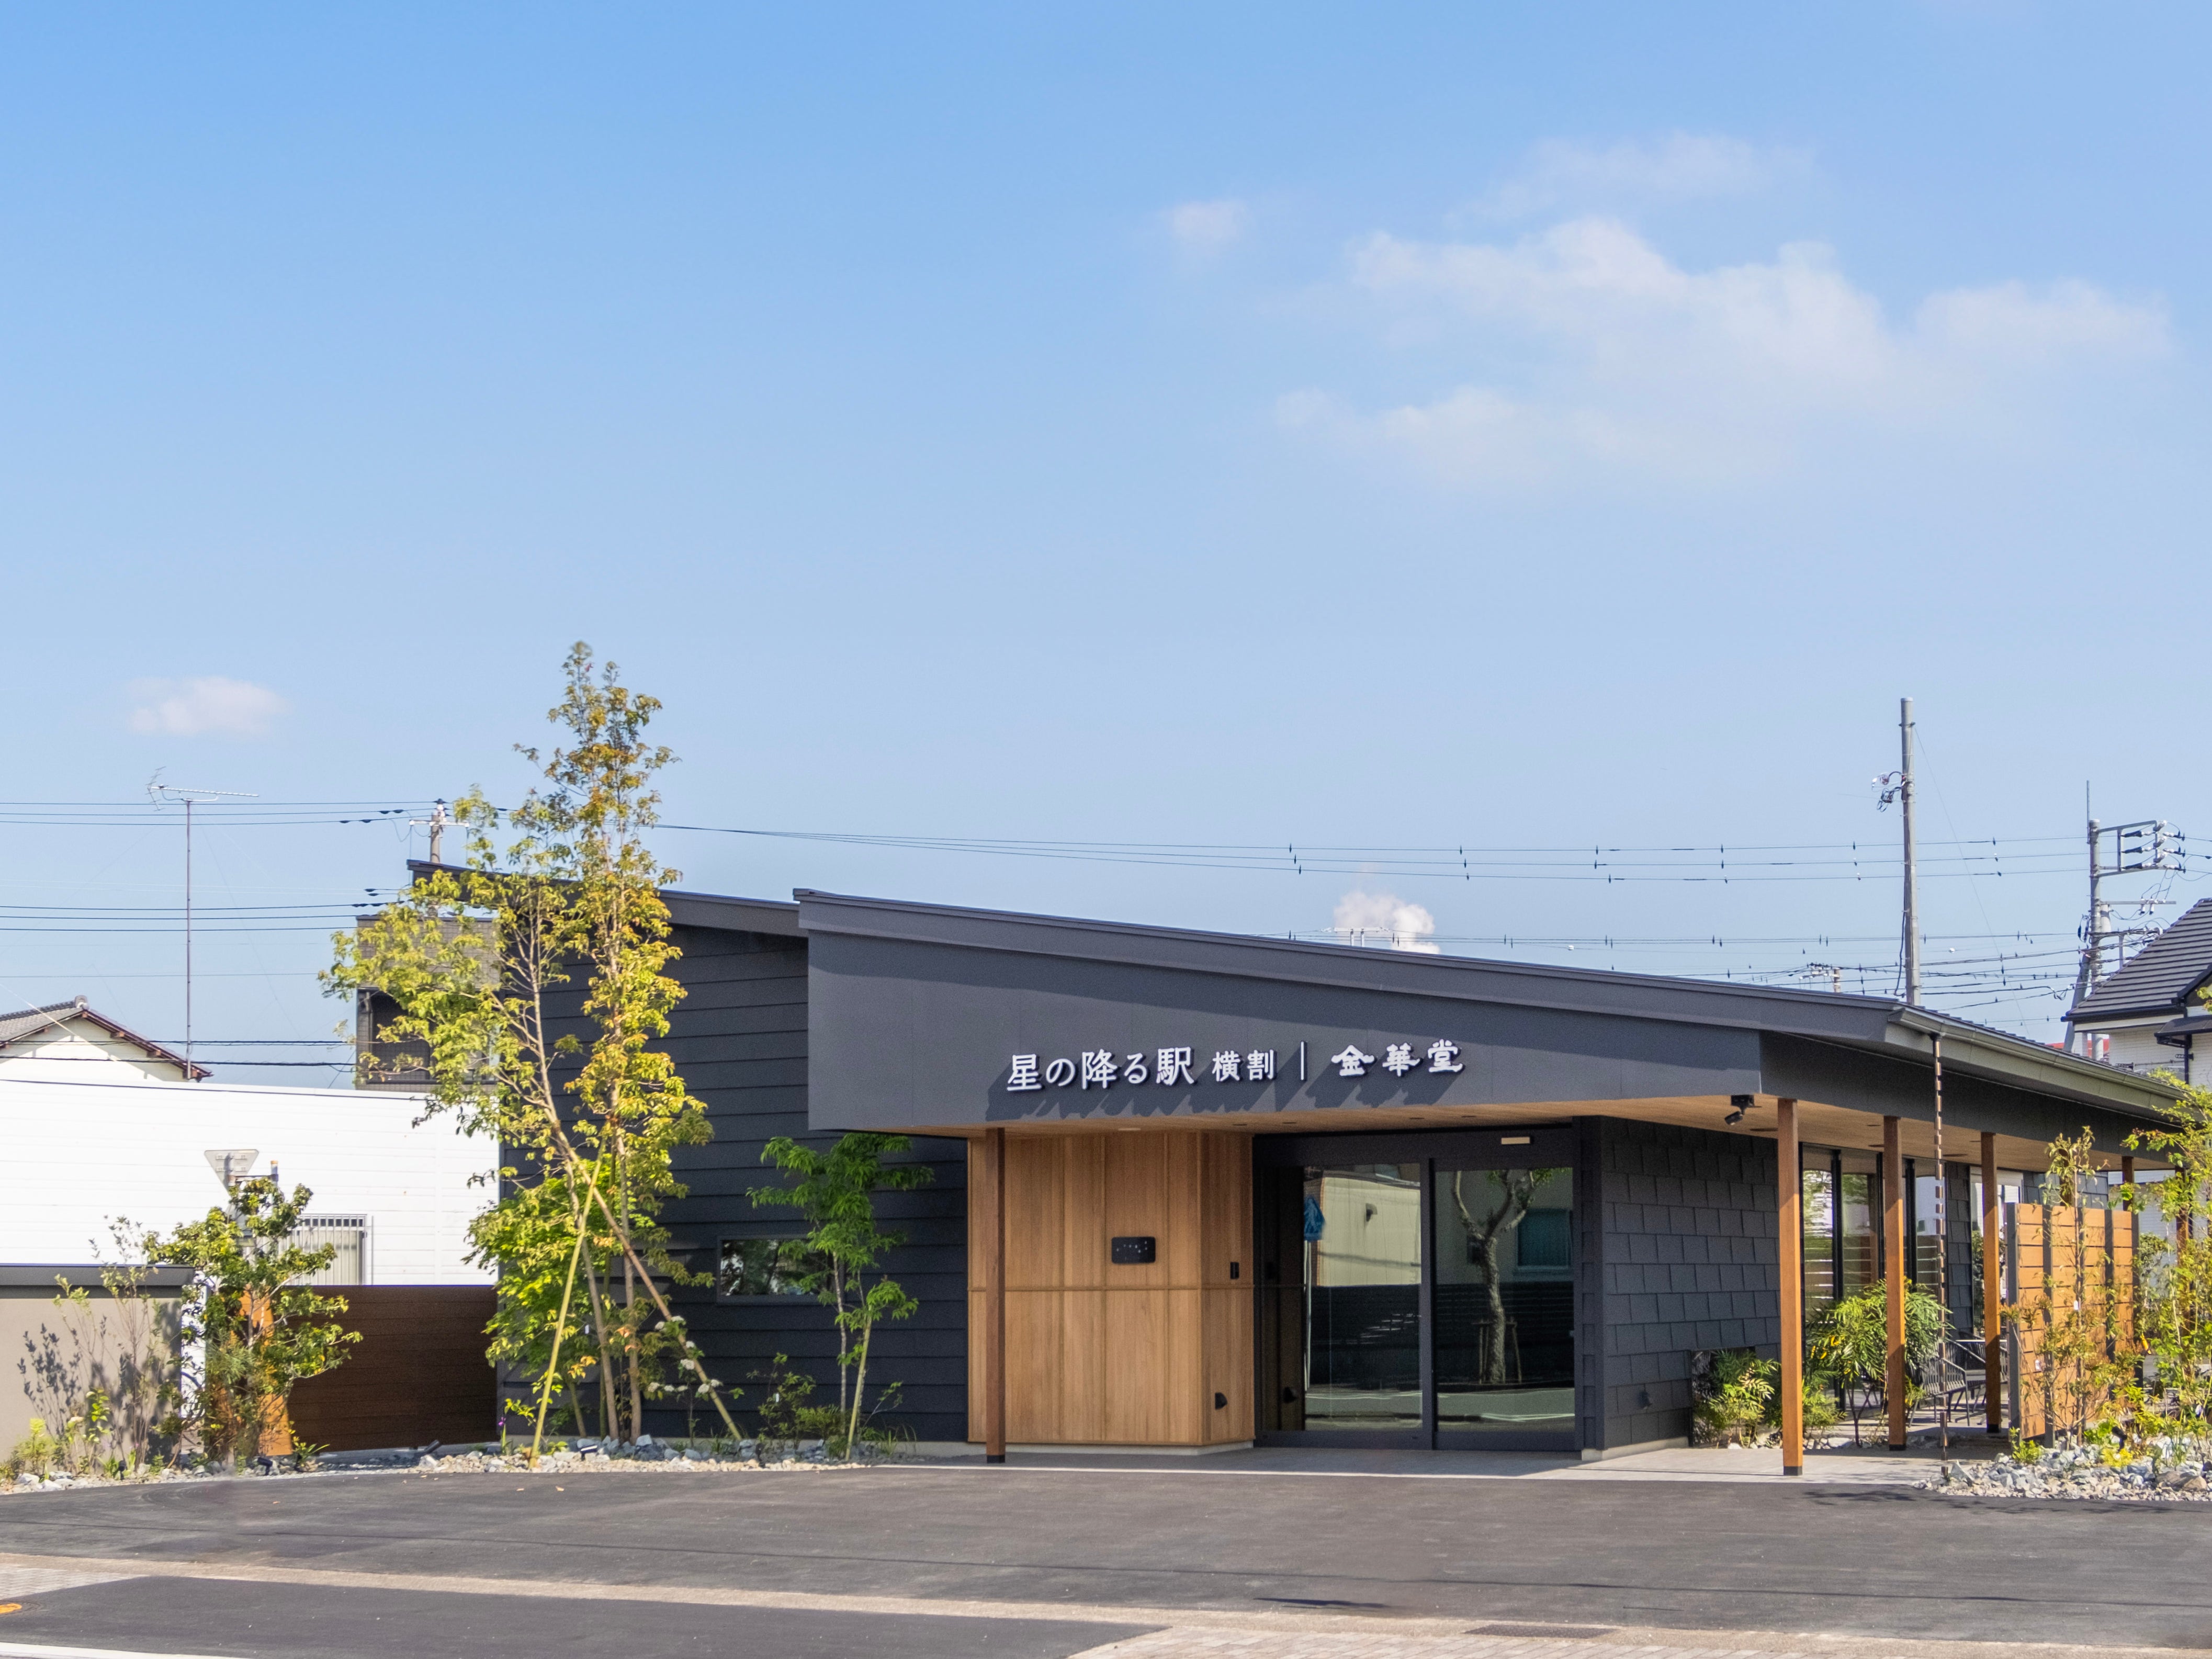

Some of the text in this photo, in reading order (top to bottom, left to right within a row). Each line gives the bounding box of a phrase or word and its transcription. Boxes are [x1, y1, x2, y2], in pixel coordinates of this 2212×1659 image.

[1007, 1039, 1463, 1091] 星の降る駅 横割 金華堂
